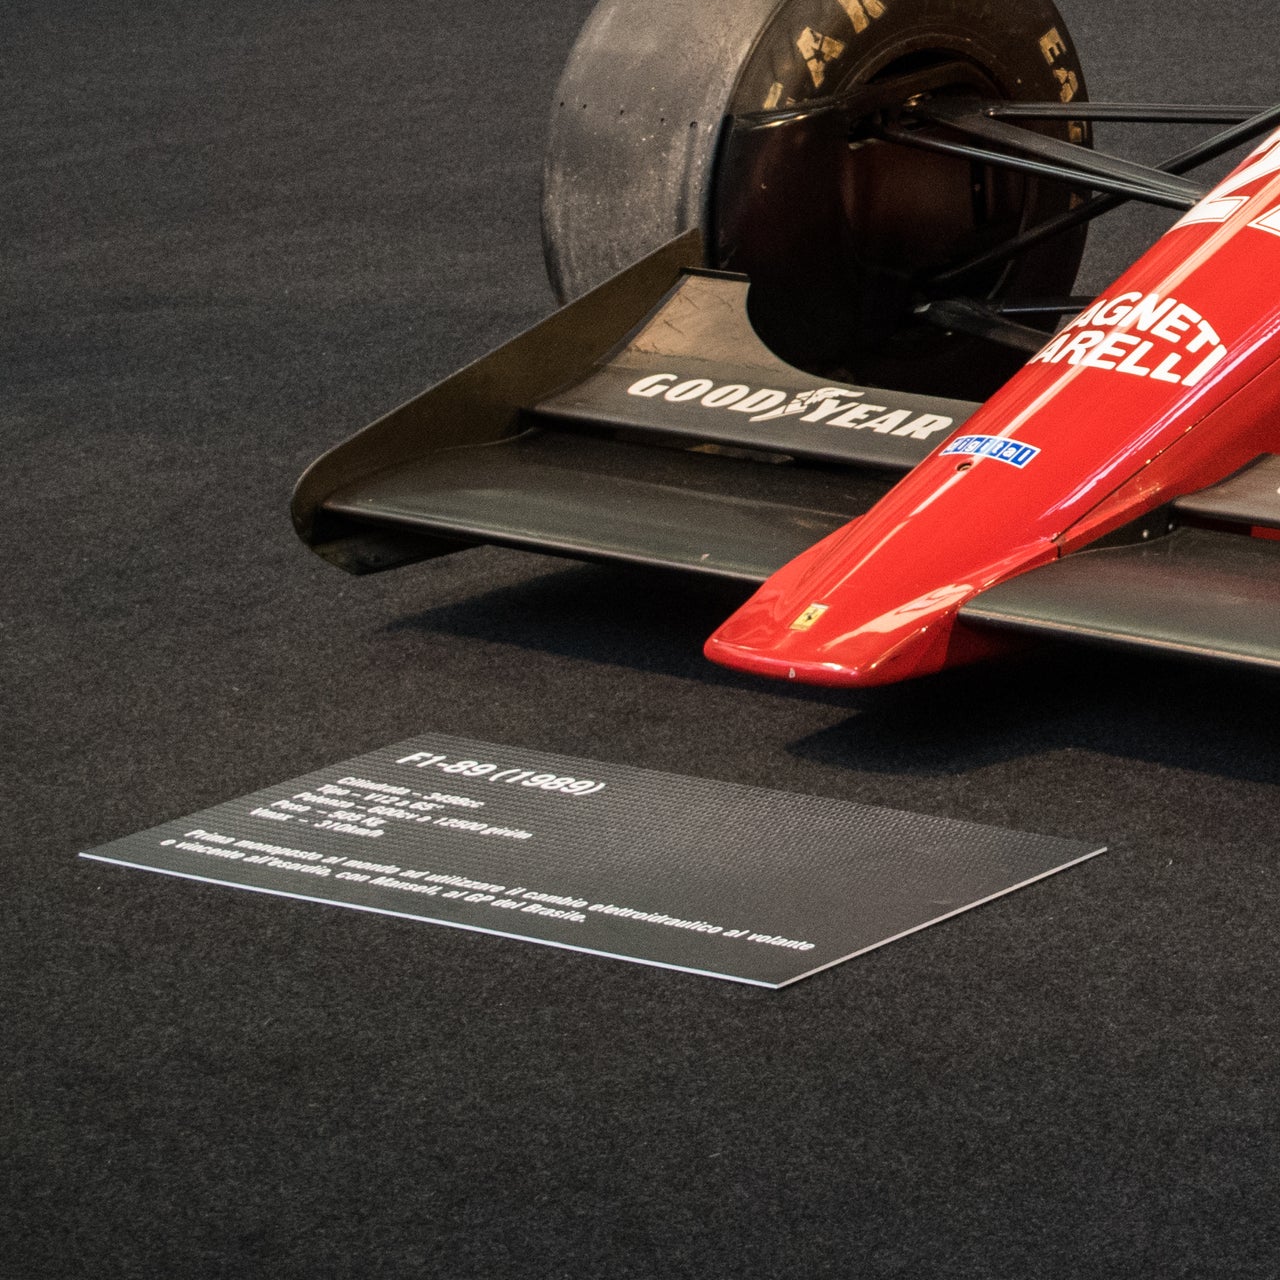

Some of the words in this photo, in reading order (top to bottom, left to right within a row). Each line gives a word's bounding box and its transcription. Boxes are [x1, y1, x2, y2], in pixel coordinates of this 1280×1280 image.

[627, 372, 954, 441] GOODYEAR
[395, 751, 497, 777] F1-89
[488, 767, 605, 796] (1989)
[432, 816, 488, 831] 12500
[174, 840, 246, 860] vincente
[242, 854, 331, 877] all'esordio,
[334, 870, 371, 882] con
[367, 875, 443, 896] Mansell,
[440, 889, 469, 899] al
[462, 892, 496, 903] GP
[489, 897, 527, 910] del
[520, 902, 586, 923] Brasile.
[183, 828, 236, 845] Prima
[232, 839, 323, 861] monoposto
[319, 855, 348, 865] al
[340, 858, 401, 874] mondo
[397, 868, 430, 879] ad
[423, 873, 505, 895] utilizzare
[521, 890, 588, 908] cambio
[587, 903, 723, 934] elettroidraulico
[721, 928, 750, 938] al
[746, 932, 815, 951] volante
